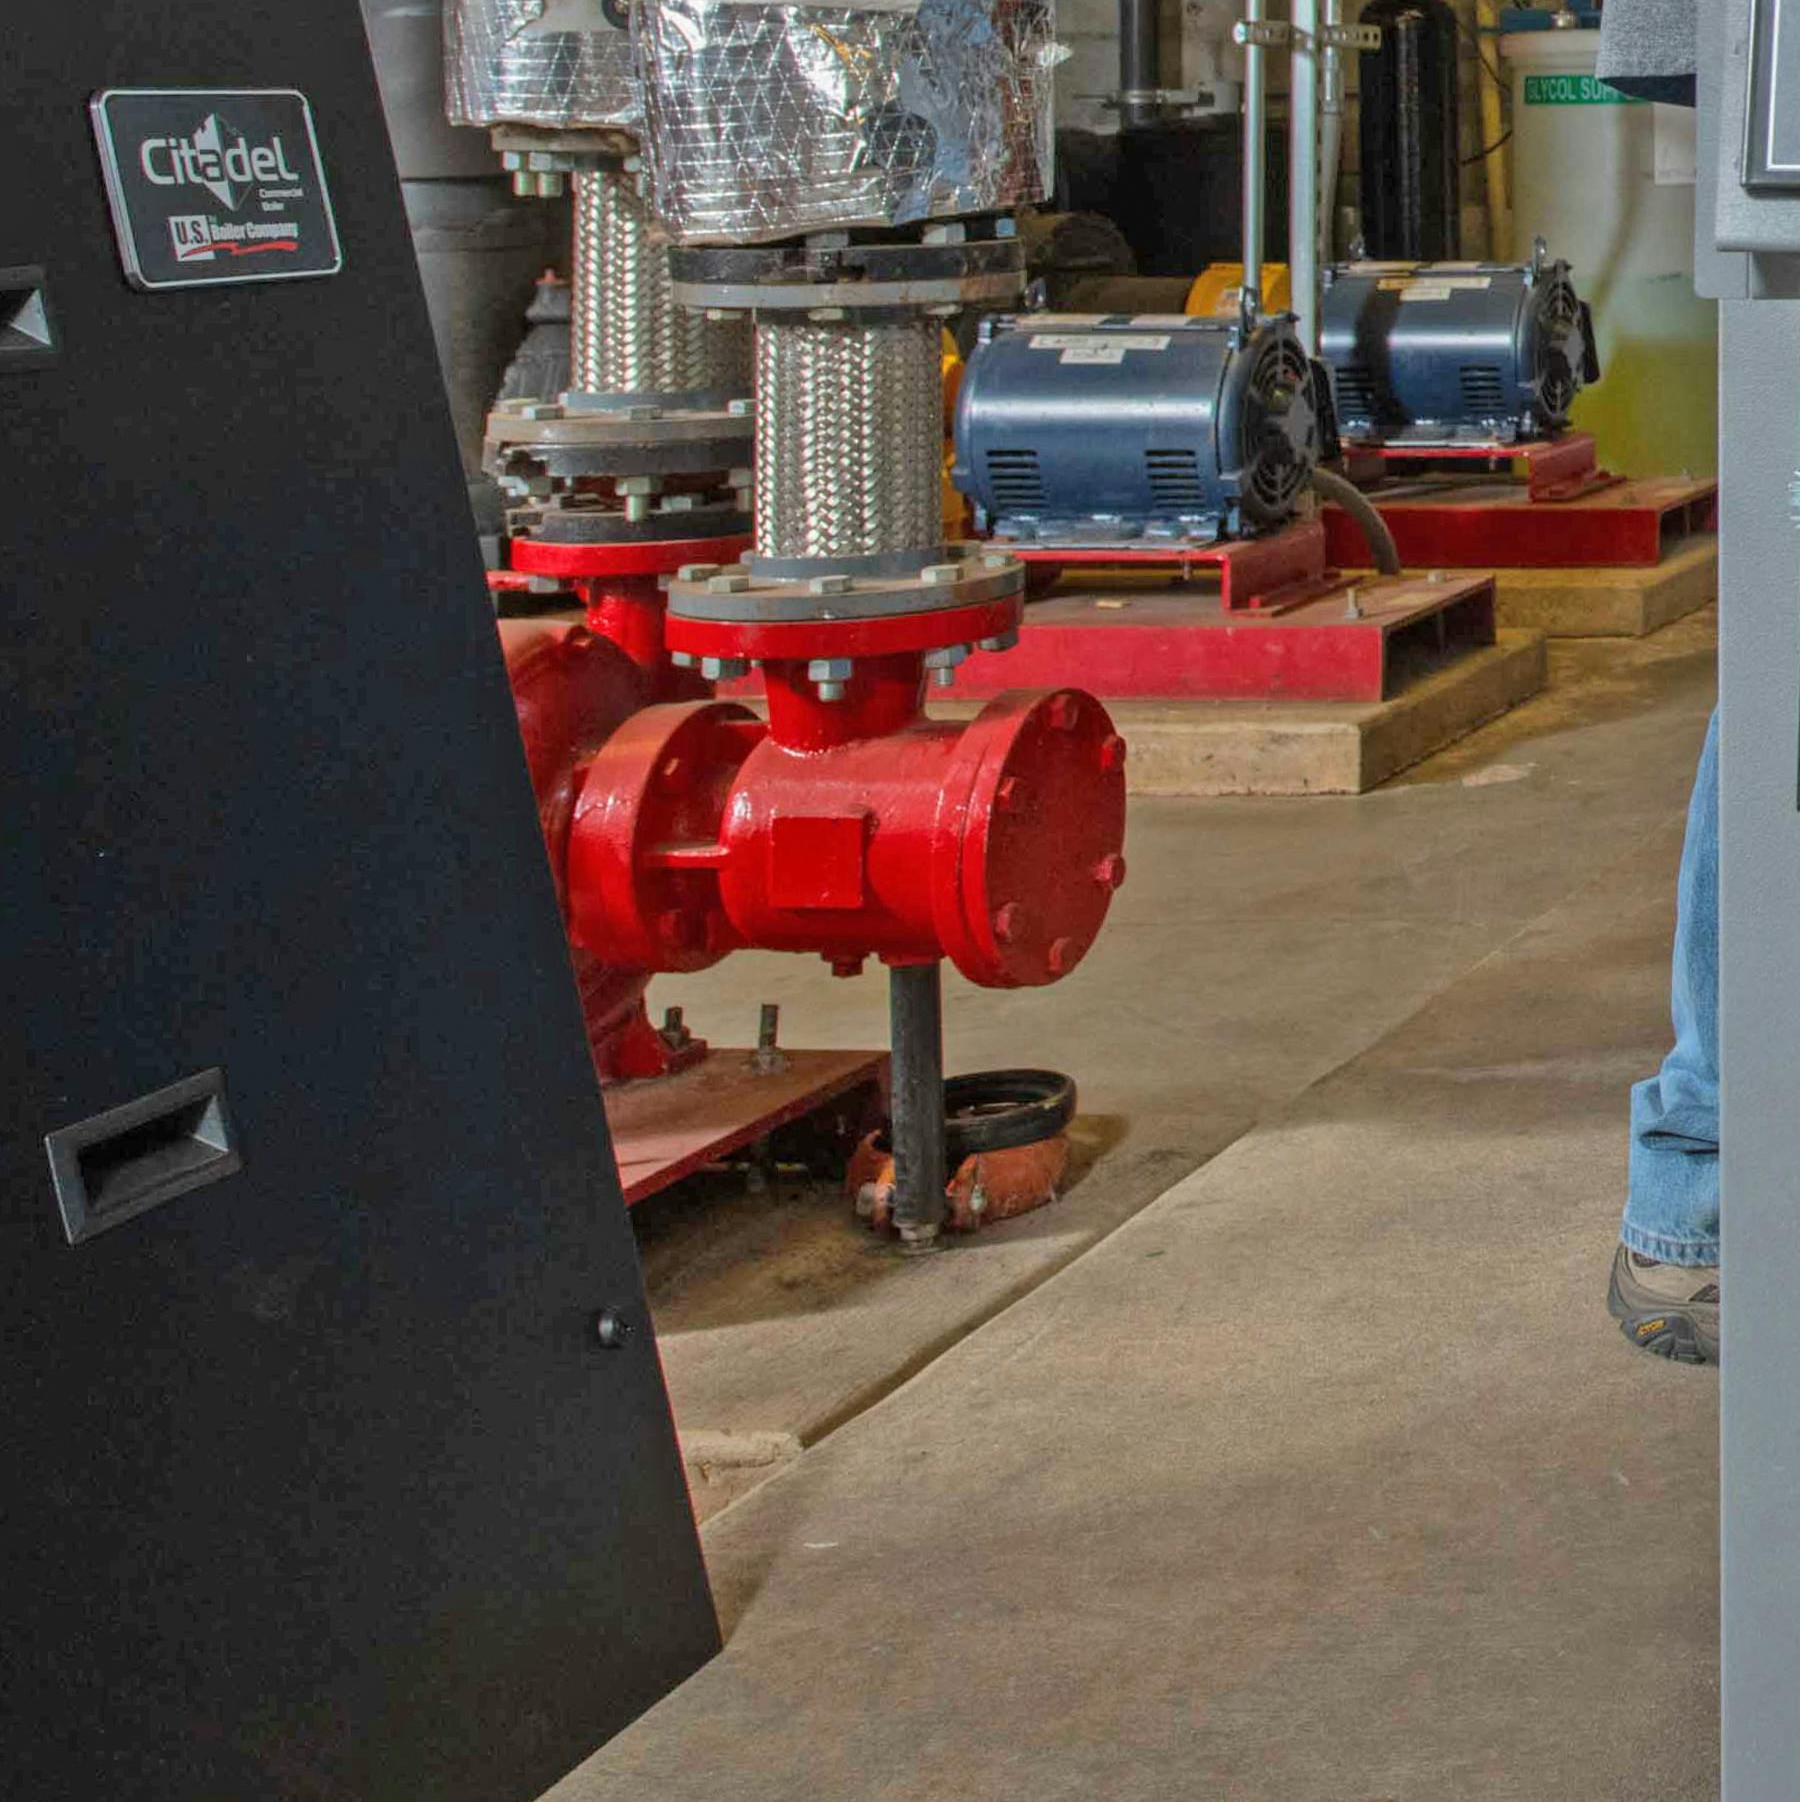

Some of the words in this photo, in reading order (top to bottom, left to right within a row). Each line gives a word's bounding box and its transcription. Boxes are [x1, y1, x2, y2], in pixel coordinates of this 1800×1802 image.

[1527, 77, 1576, 100] GLYCOL
[140, 135, 299, 186] Citadel
[174, 218, 210, 245] U.S.
